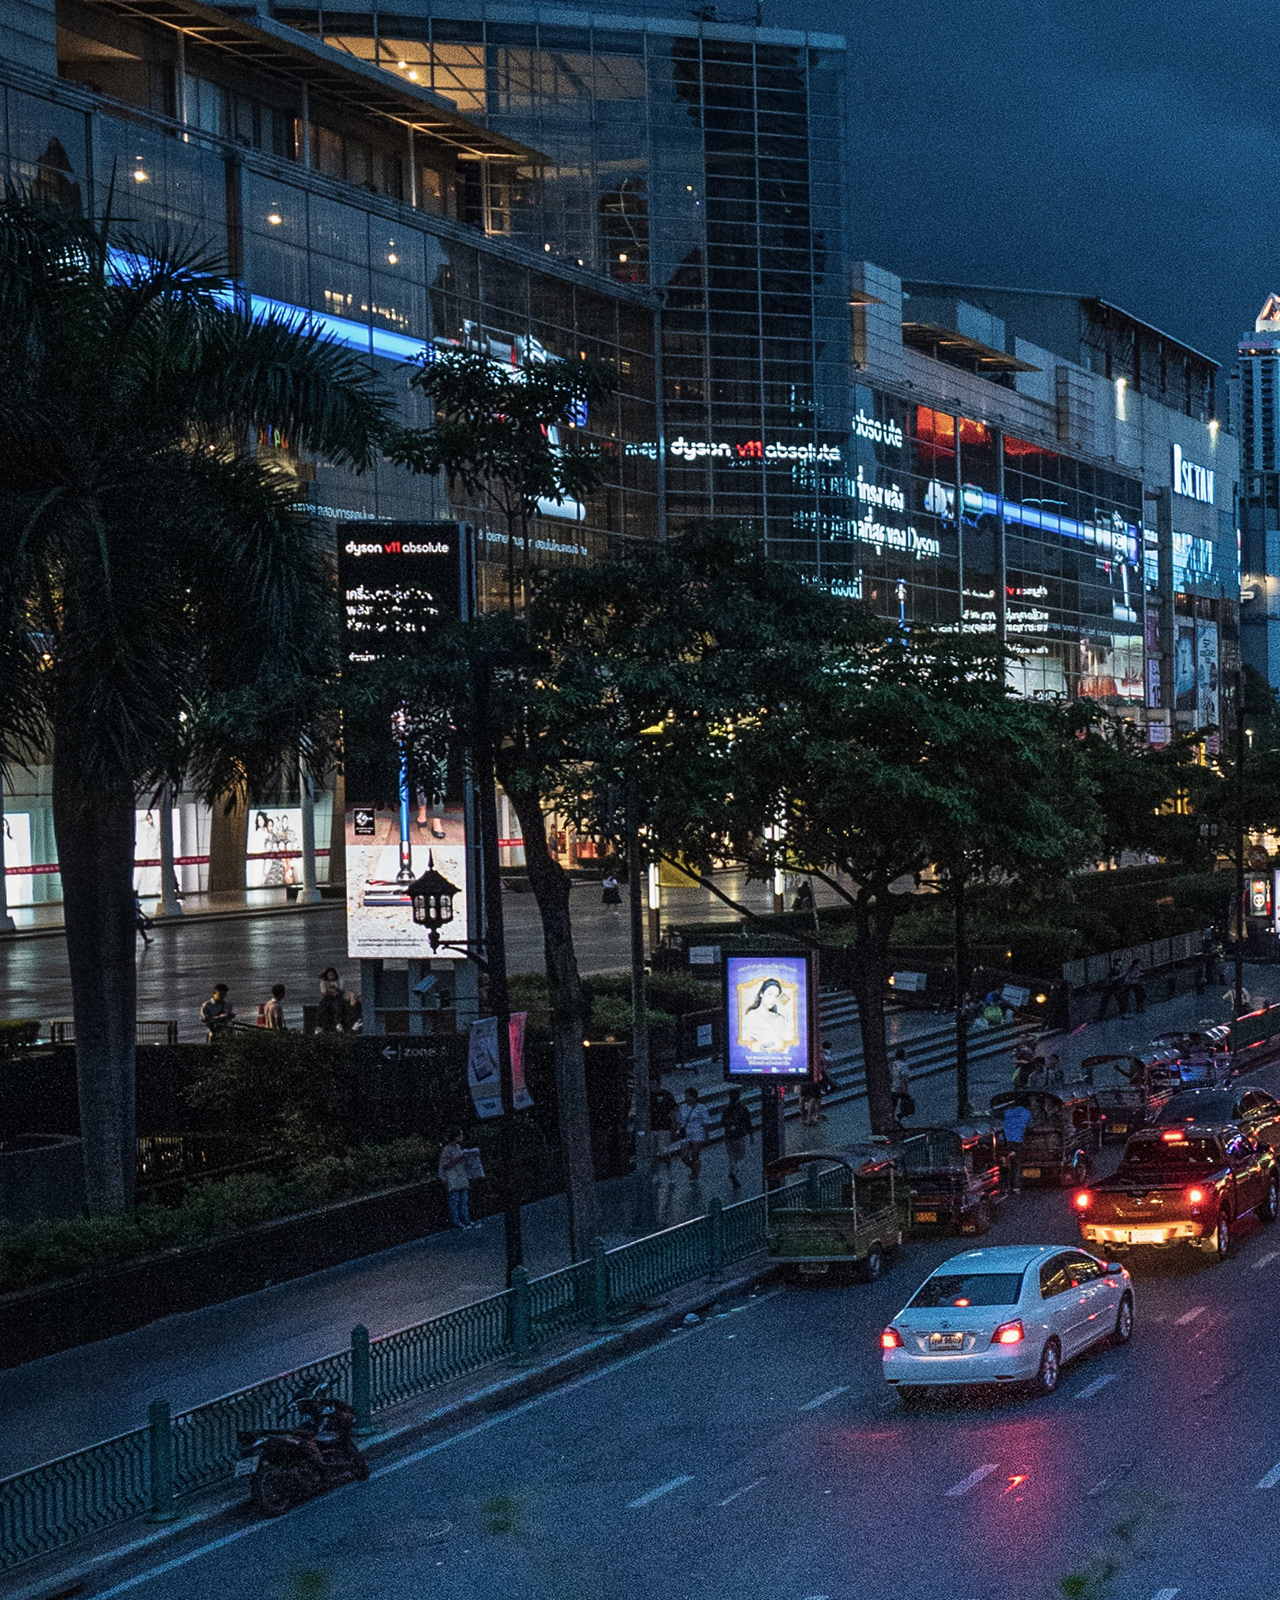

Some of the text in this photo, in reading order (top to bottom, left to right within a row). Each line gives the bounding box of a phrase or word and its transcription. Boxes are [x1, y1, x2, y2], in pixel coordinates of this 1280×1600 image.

[670, 436, 731, 461] dyson
[765, 441, 841, 461] absolute
[1173, 443, 1215, 505] ISETAN
[345, 541, 449, 556] dyson v11 absolute
